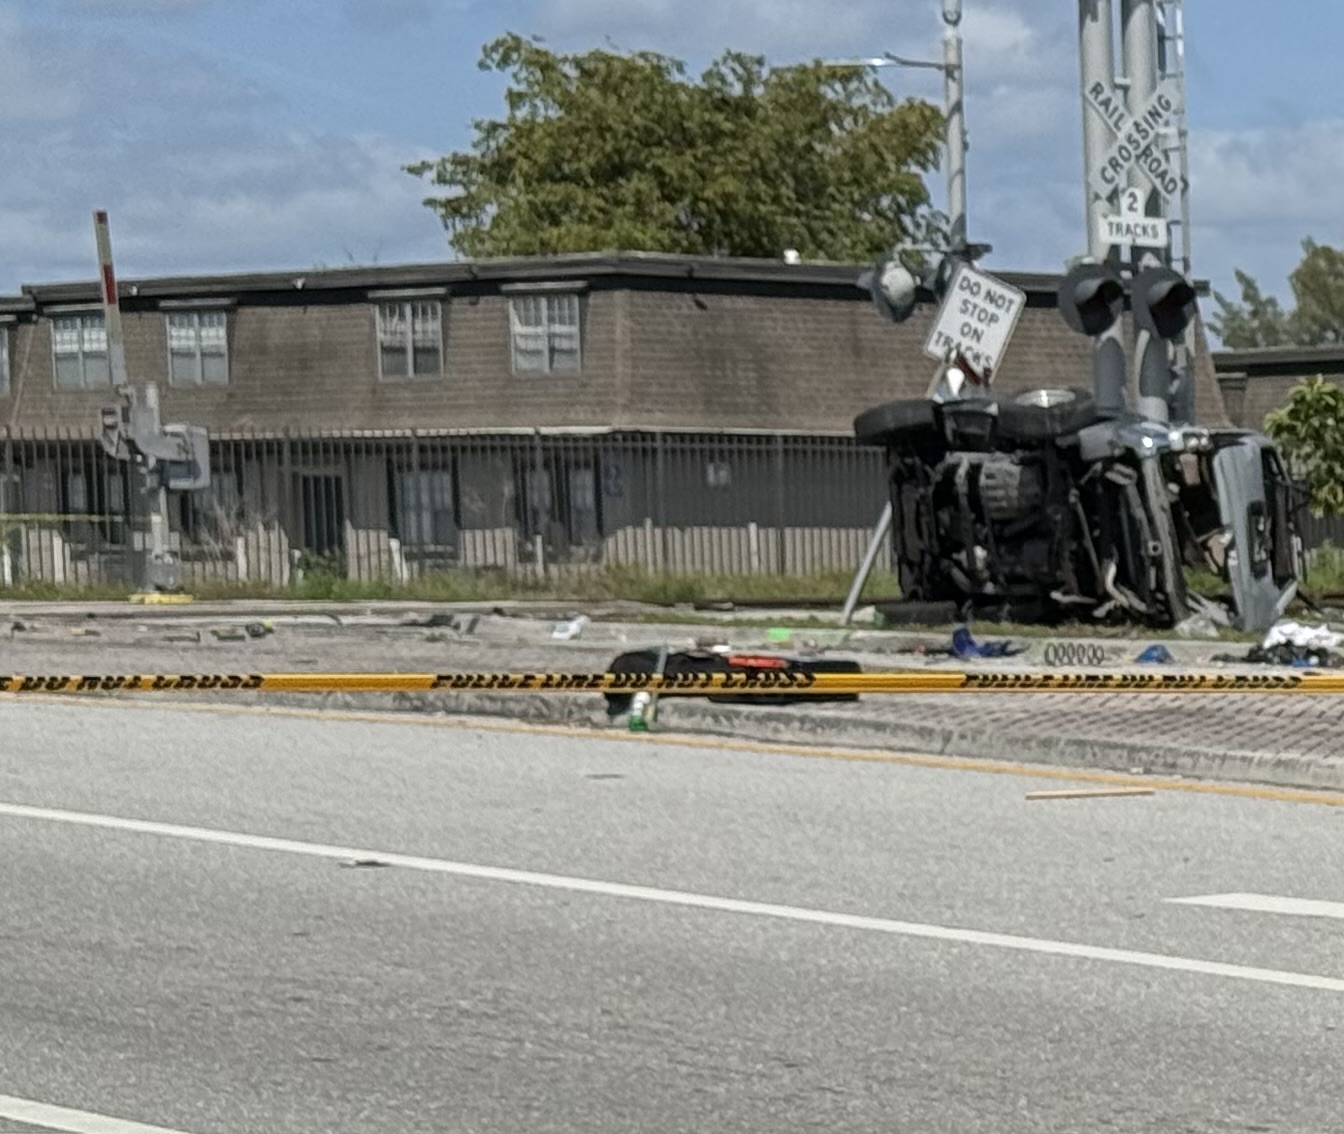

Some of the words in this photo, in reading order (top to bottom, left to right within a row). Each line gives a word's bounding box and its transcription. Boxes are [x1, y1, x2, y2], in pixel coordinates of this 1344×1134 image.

[1089, 82, 1125, 132] RAIL
[1100, 94, 1172, 184] CROSSING
[1135, 143, 1178, 194] ROAD
[1127, 191, 1138, 212] 2
[1108, 221, 1159, 239] TRACKS
[958, 275, 981, 297] DO
[984, 289, 1015, 314] NOT
[959, 298, 1000, 327] STOP
[960, 322, 984, 344] ON
